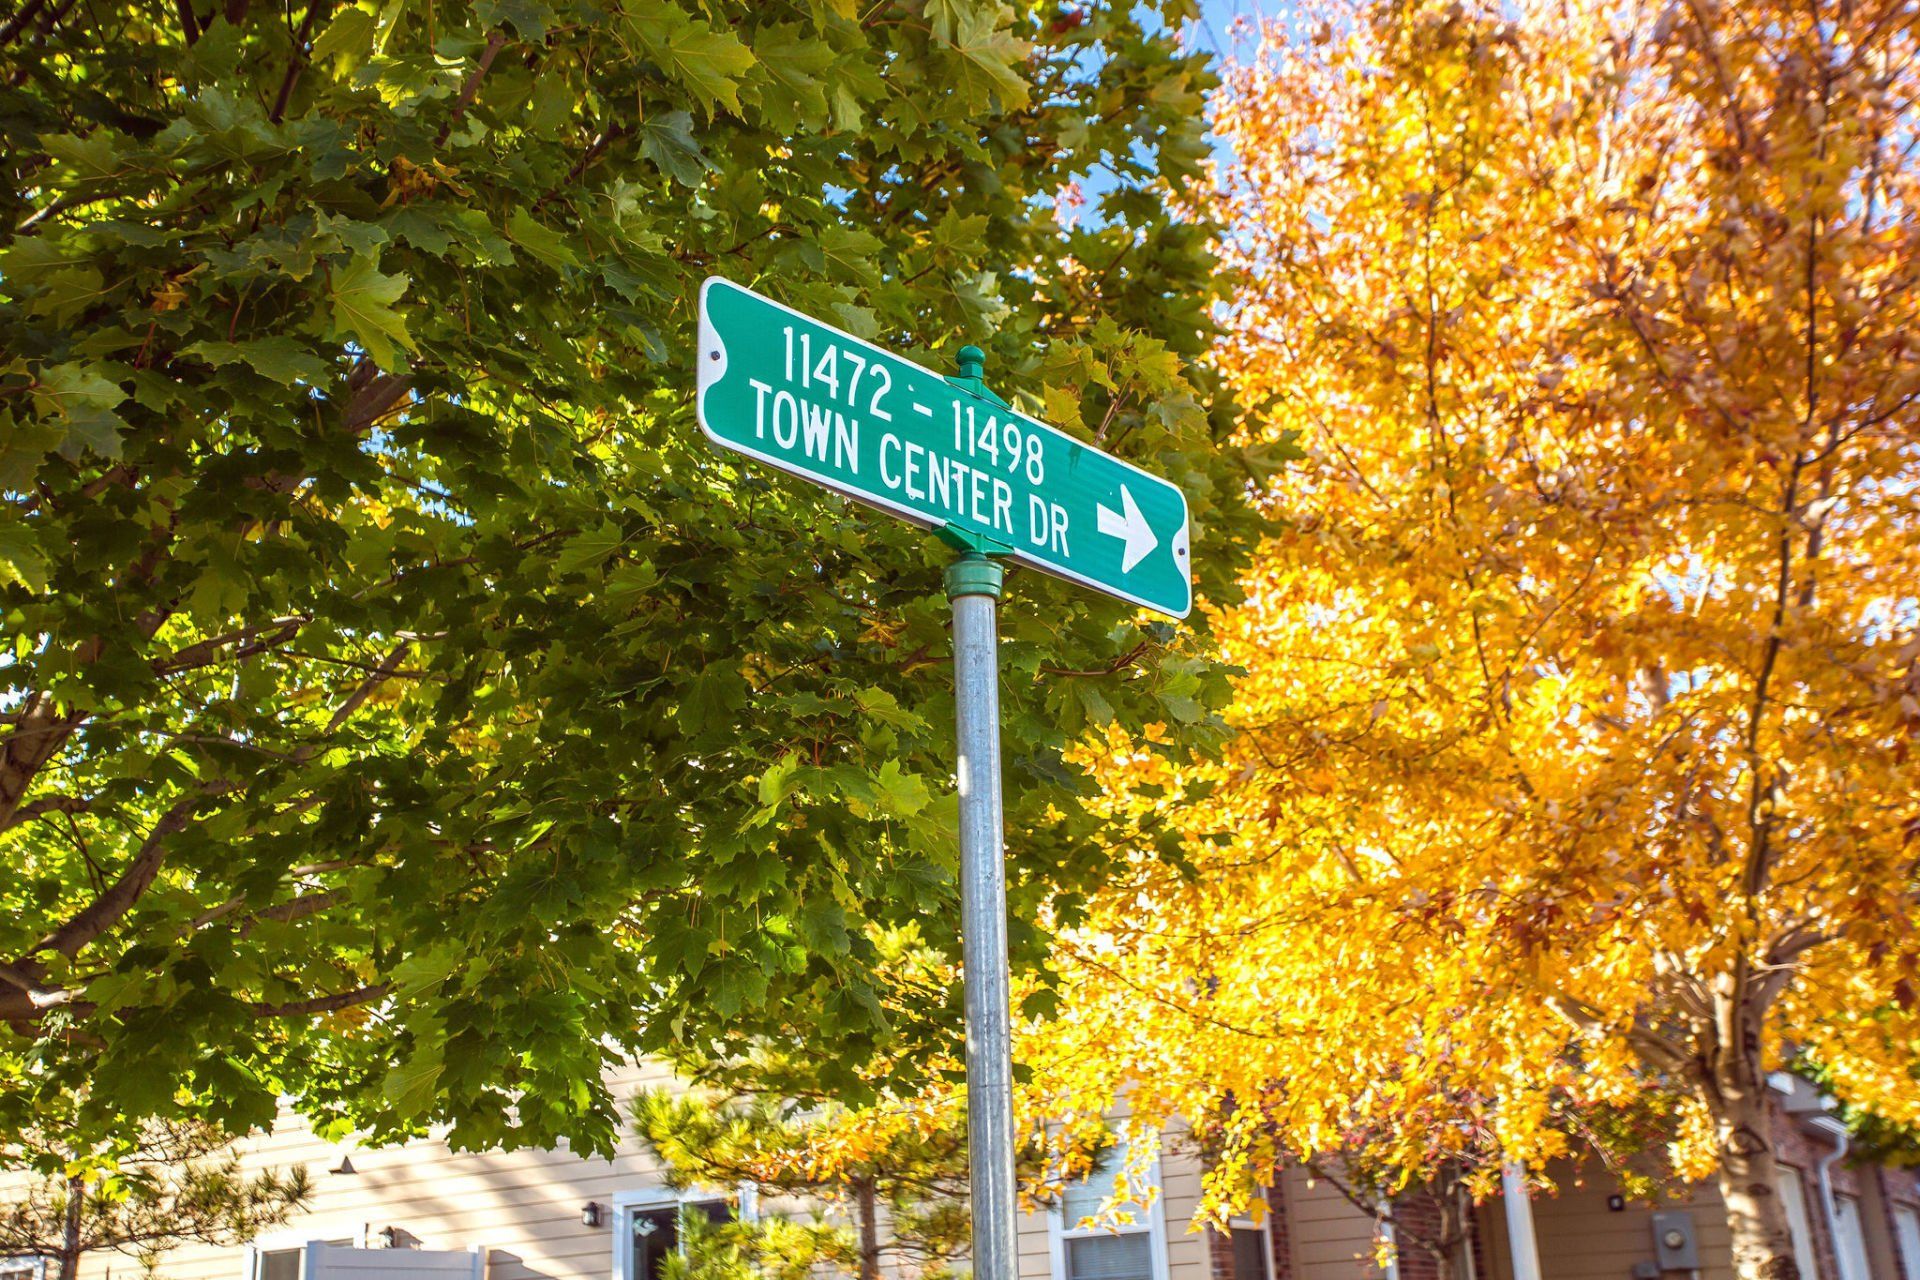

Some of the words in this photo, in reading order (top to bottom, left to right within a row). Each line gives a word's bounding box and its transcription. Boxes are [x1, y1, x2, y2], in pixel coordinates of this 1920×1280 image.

[749, 378, 859, 474] TOWN
[879, 432, 1013, 535] CENTER
[1029, 493, 1070, 558] DR
[784, 326, 892, 422] 11472
[953, 399, 1044, 486] 11498
